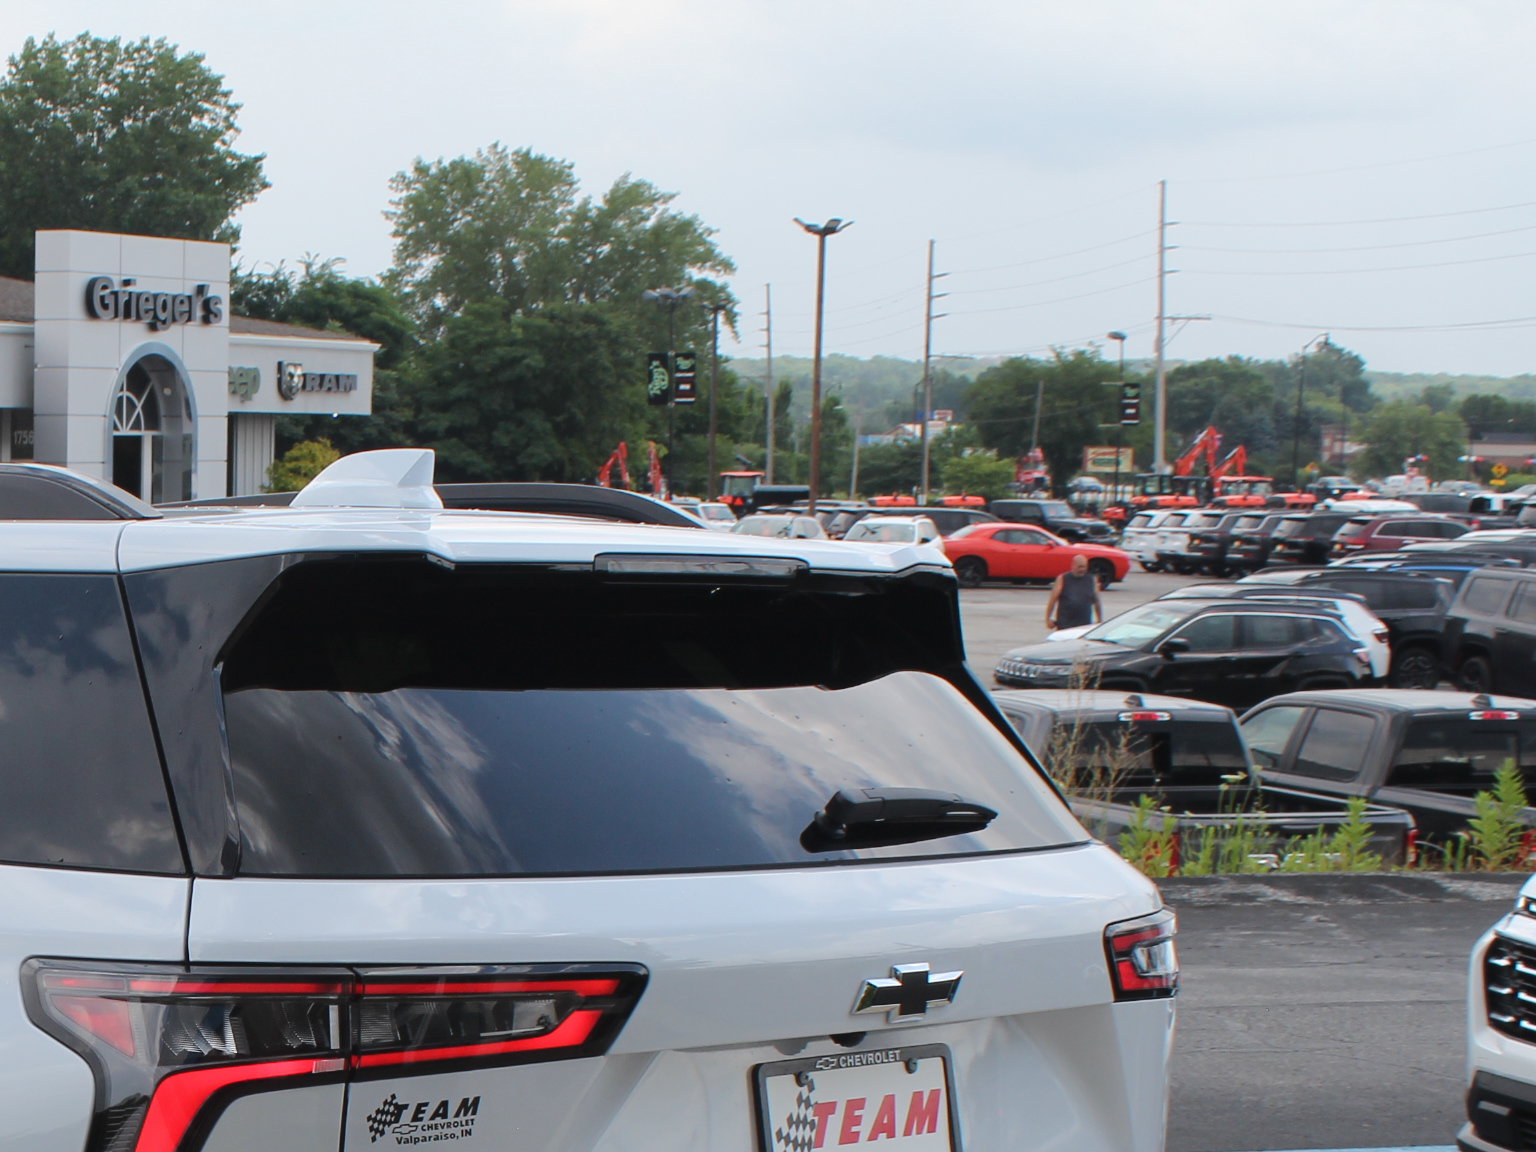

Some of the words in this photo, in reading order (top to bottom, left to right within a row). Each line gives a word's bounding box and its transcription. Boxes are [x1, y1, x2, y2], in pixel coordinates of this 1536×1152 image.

[85, 276, 223, 332] Grieger's
[228, 366, 261, 402] eep
[303, 372, 358, 392] RAM
[839, 1050, 901, 1067] CHEVROLET
[392, 1096, 481, 1123] TEAM
[813, 1088, 941, 1149] TEAM
[396, 1131, 459, 1145] Valparaiso,
[461, 1128, 472, 1138] IN
[421, 1118, 475, 1132] CHEVROLET
